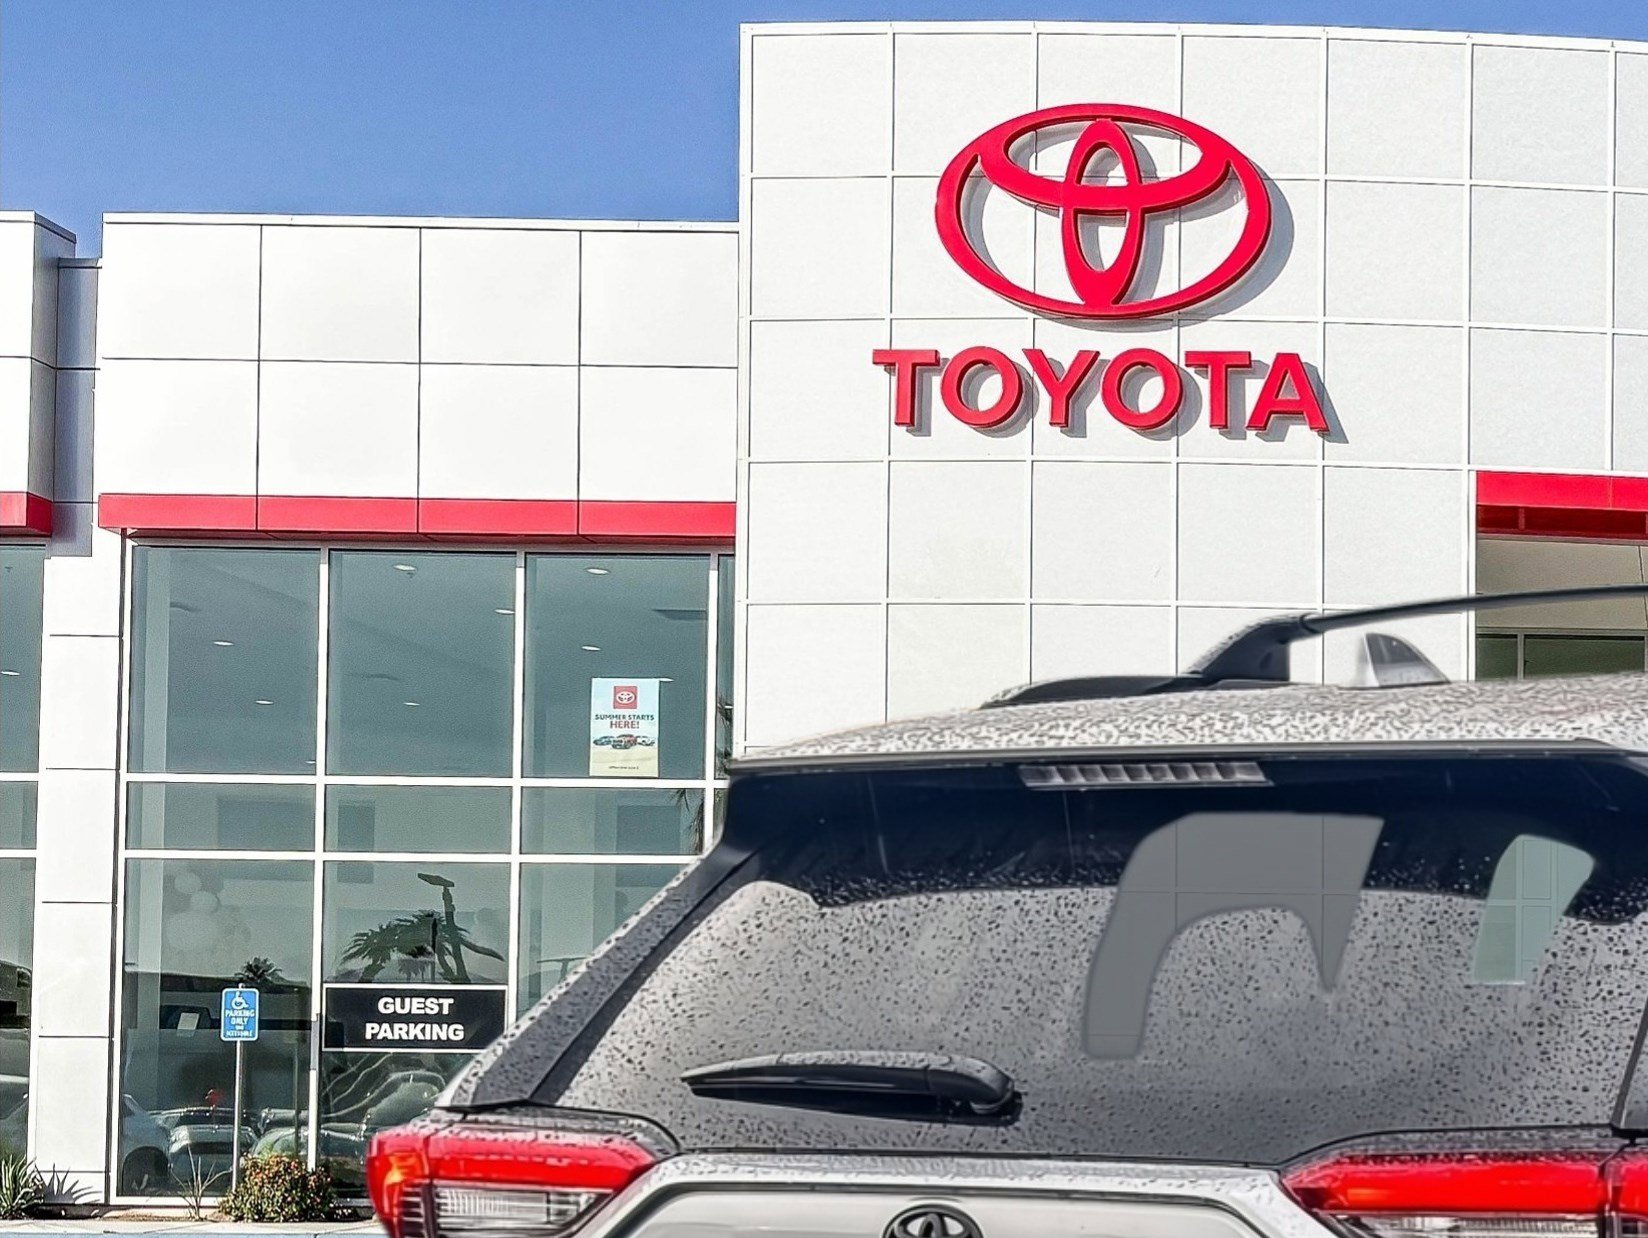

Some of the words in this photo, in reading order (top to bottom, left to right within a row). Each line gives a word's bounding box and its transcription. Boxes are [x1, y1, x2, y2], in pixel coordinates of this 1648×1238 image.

[872, 346, 1330, 431] TOYOTA
[609, 720, 640, 729] HERE!
[225, 1009, 256, 1017] PARKING
[377, 996, 454, 1015] GUEST
[365, 1022, 465, 1041] PARKING
